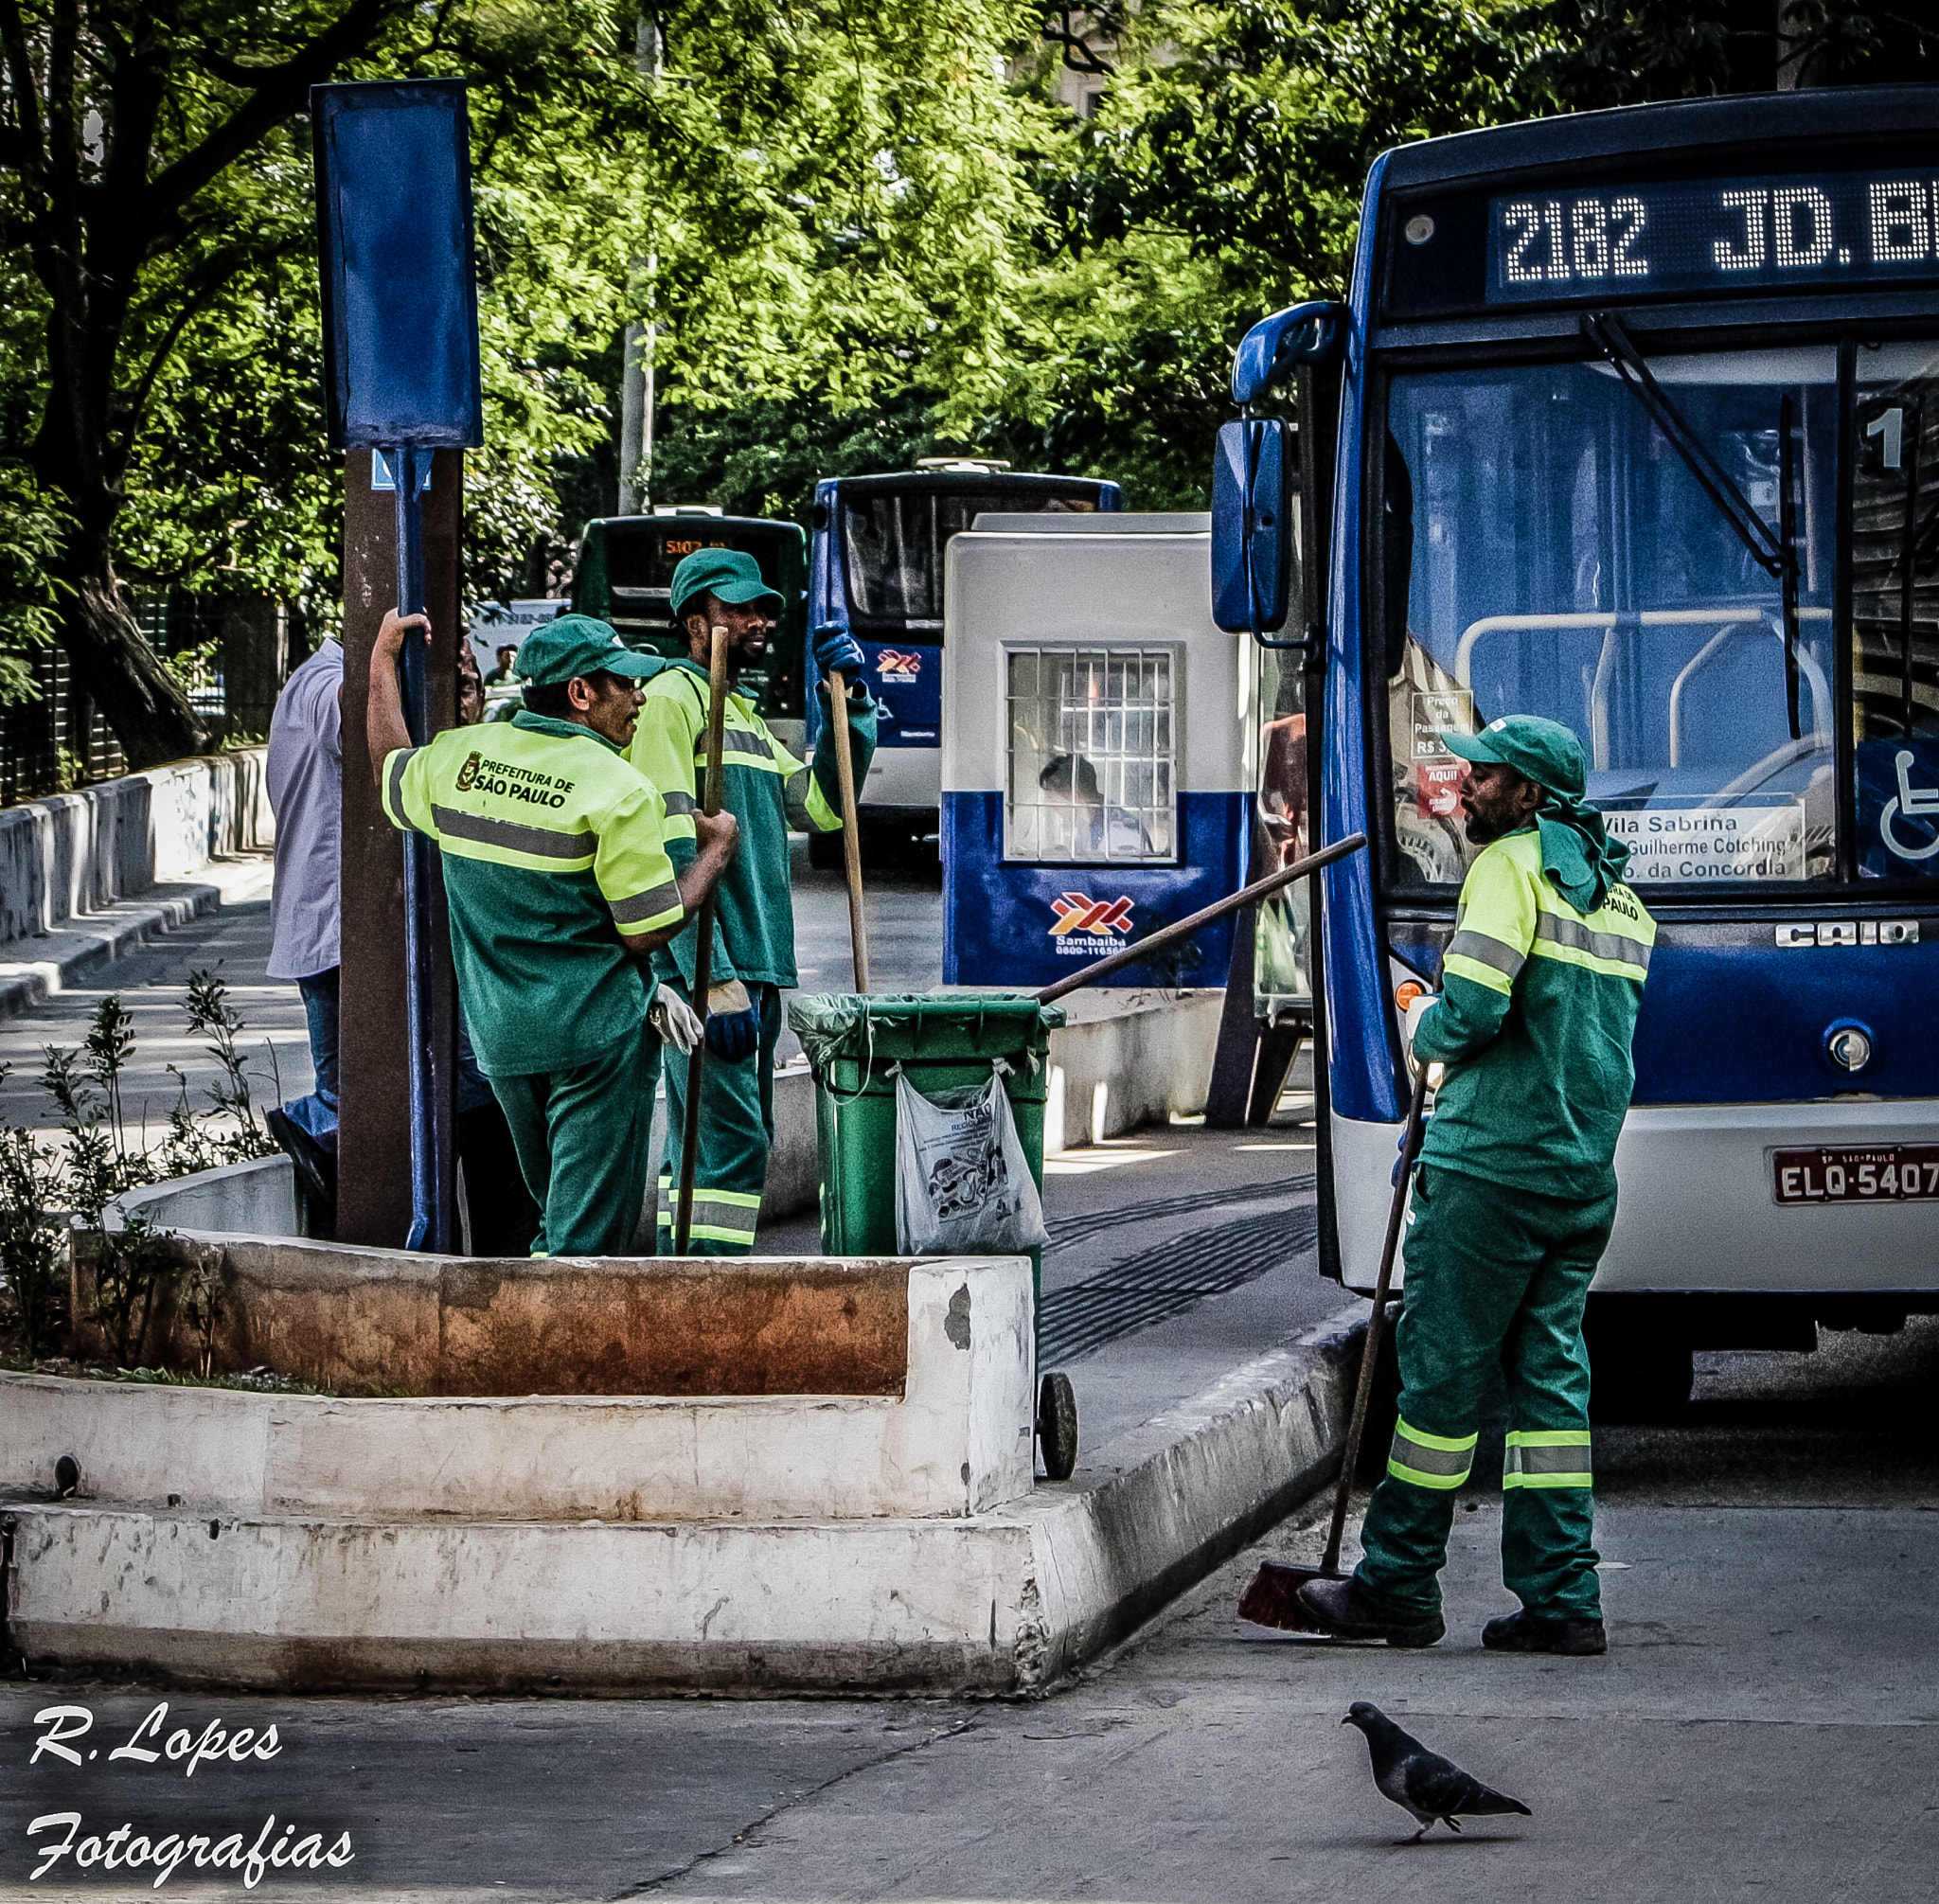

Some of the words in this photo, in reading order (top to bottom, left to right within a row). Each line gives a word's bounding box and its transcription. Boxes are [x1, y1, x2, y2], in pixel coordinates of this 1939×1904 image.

[1505, 196, 1649, 281] 2182
[1714, 187, 1851, 270] JD.
[1869, 180, 1939, 261] B
[1867, 408, 1903, 468] 1
[1417, 741, 1435, 754] R$
[481, 758, 552, 787] PREFEITURA
[555, 777, 576, 794] DE
[474, 774, 507, 795] SÃO
[508, 785, 566, 810] PAULO
[1648, 815, 1738, 833] Sabrina
[1627, 839, 1708, 856] Guilherme
[1647, 863, 1672, 879] da
[1602, 897, 1639, 922] PAULO
[1056, 935, 1127, 947] Sambaiba
